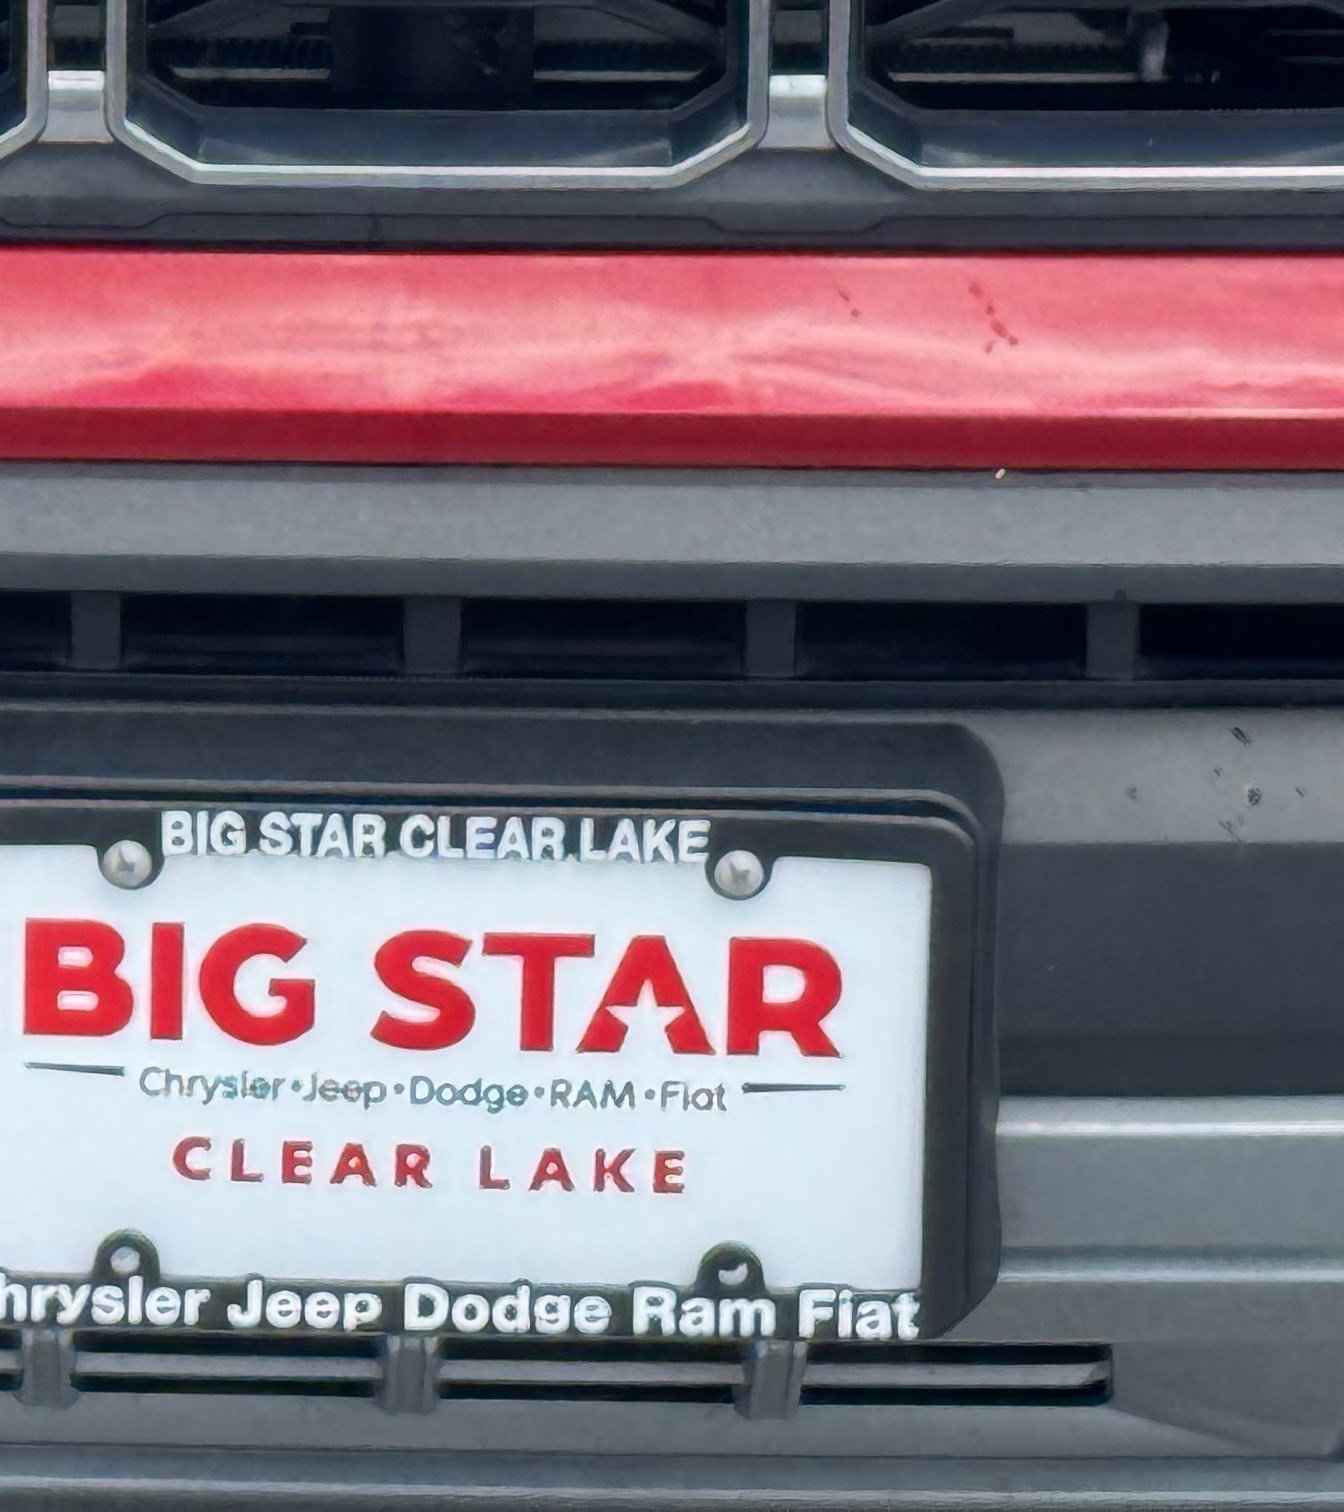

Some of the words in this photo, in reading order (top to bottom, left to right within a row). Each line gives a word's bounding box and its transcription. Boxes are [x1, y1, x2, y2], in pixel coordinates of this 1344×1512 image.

[160, 810, 247, 855] BIG
[257, 811, 386, 858] STAR
[398, 814, 565, 861] CLEAR
[579, 818, 711, 863] LAKE
[23, 917, 316, 1046] BIG
[370, 928, 844, 1059] STAR
[172, 1135, 432, 1191] CLEAR
[478, 1144, 686, 1194] LAKE
[227, 1280, 384, 1333] Jeep
[402, 1283, 614, 1335] Dodge
[631, 1288, 777, 1338] Ram
[798, 1291, 922, 1341] Fiat
